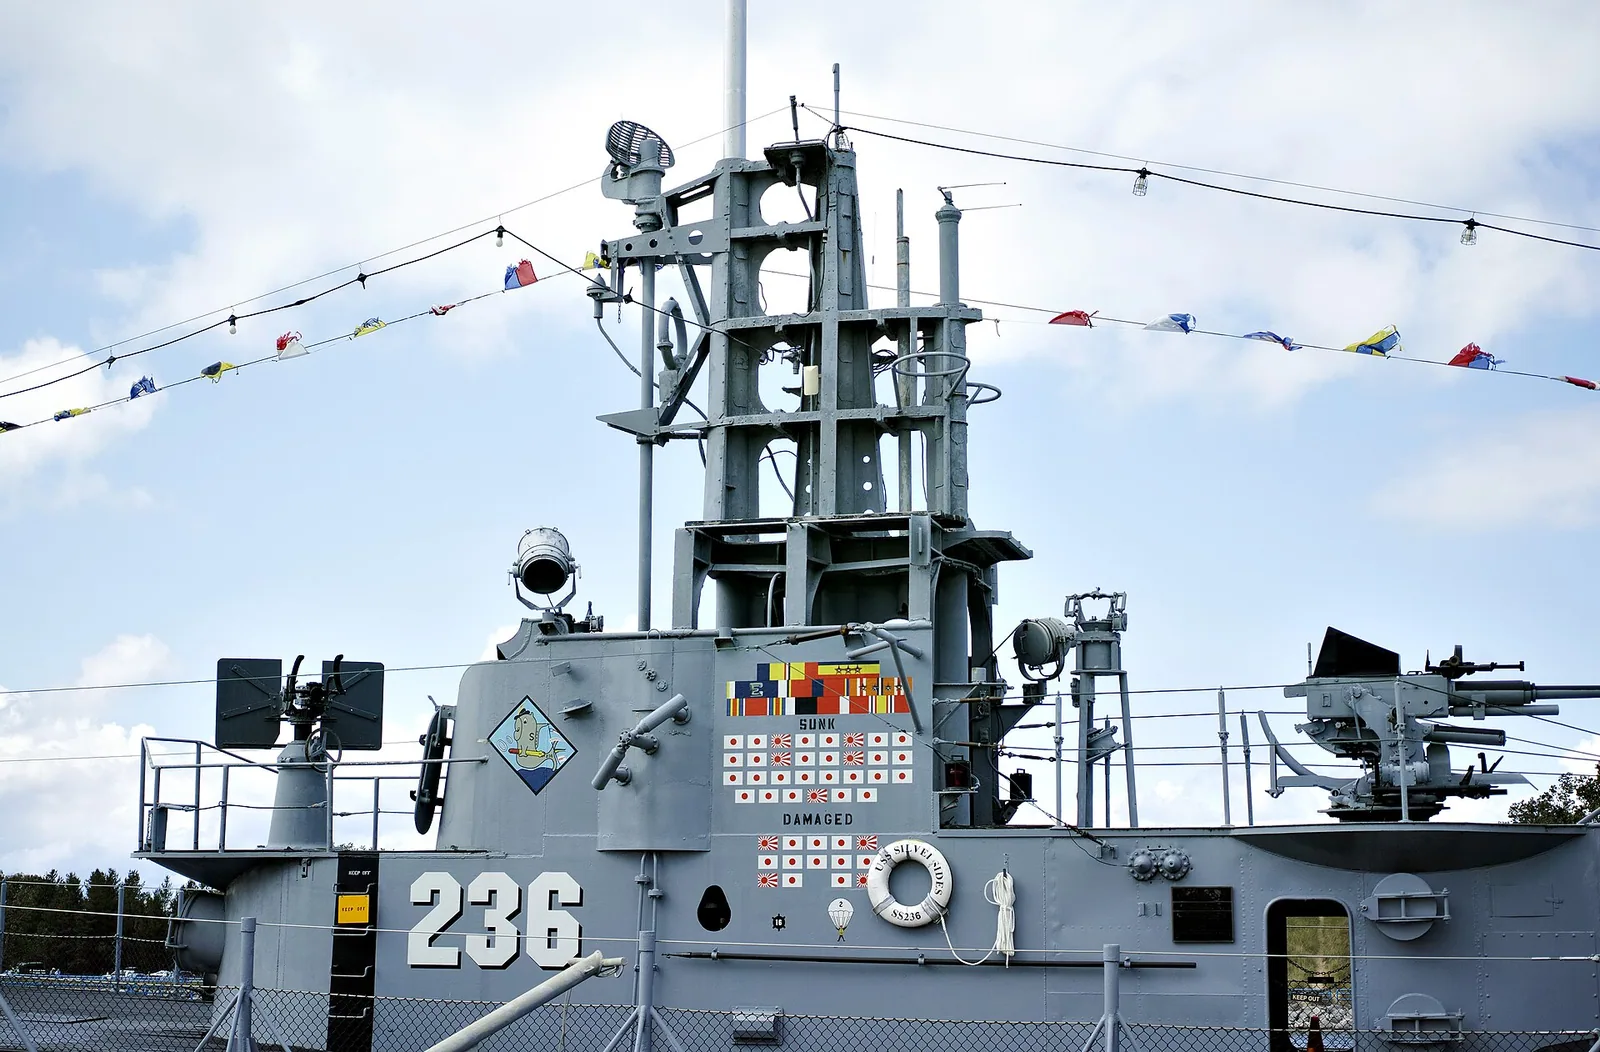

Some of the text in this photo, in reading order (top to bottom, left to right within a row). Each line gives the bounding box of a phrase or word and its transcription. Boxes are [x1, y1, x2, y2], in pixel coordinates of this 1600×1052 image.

[799, 718, 835, 730] SUNK
[529, 732, 535, 741] S
[783, 813, 853, 826] DAMAGED
[875, 853, 892, 872] USS
[407, 872, 583, 970] 236
[891, 908, 922, 922] SS236
[775, 918, 783, 926] 16
